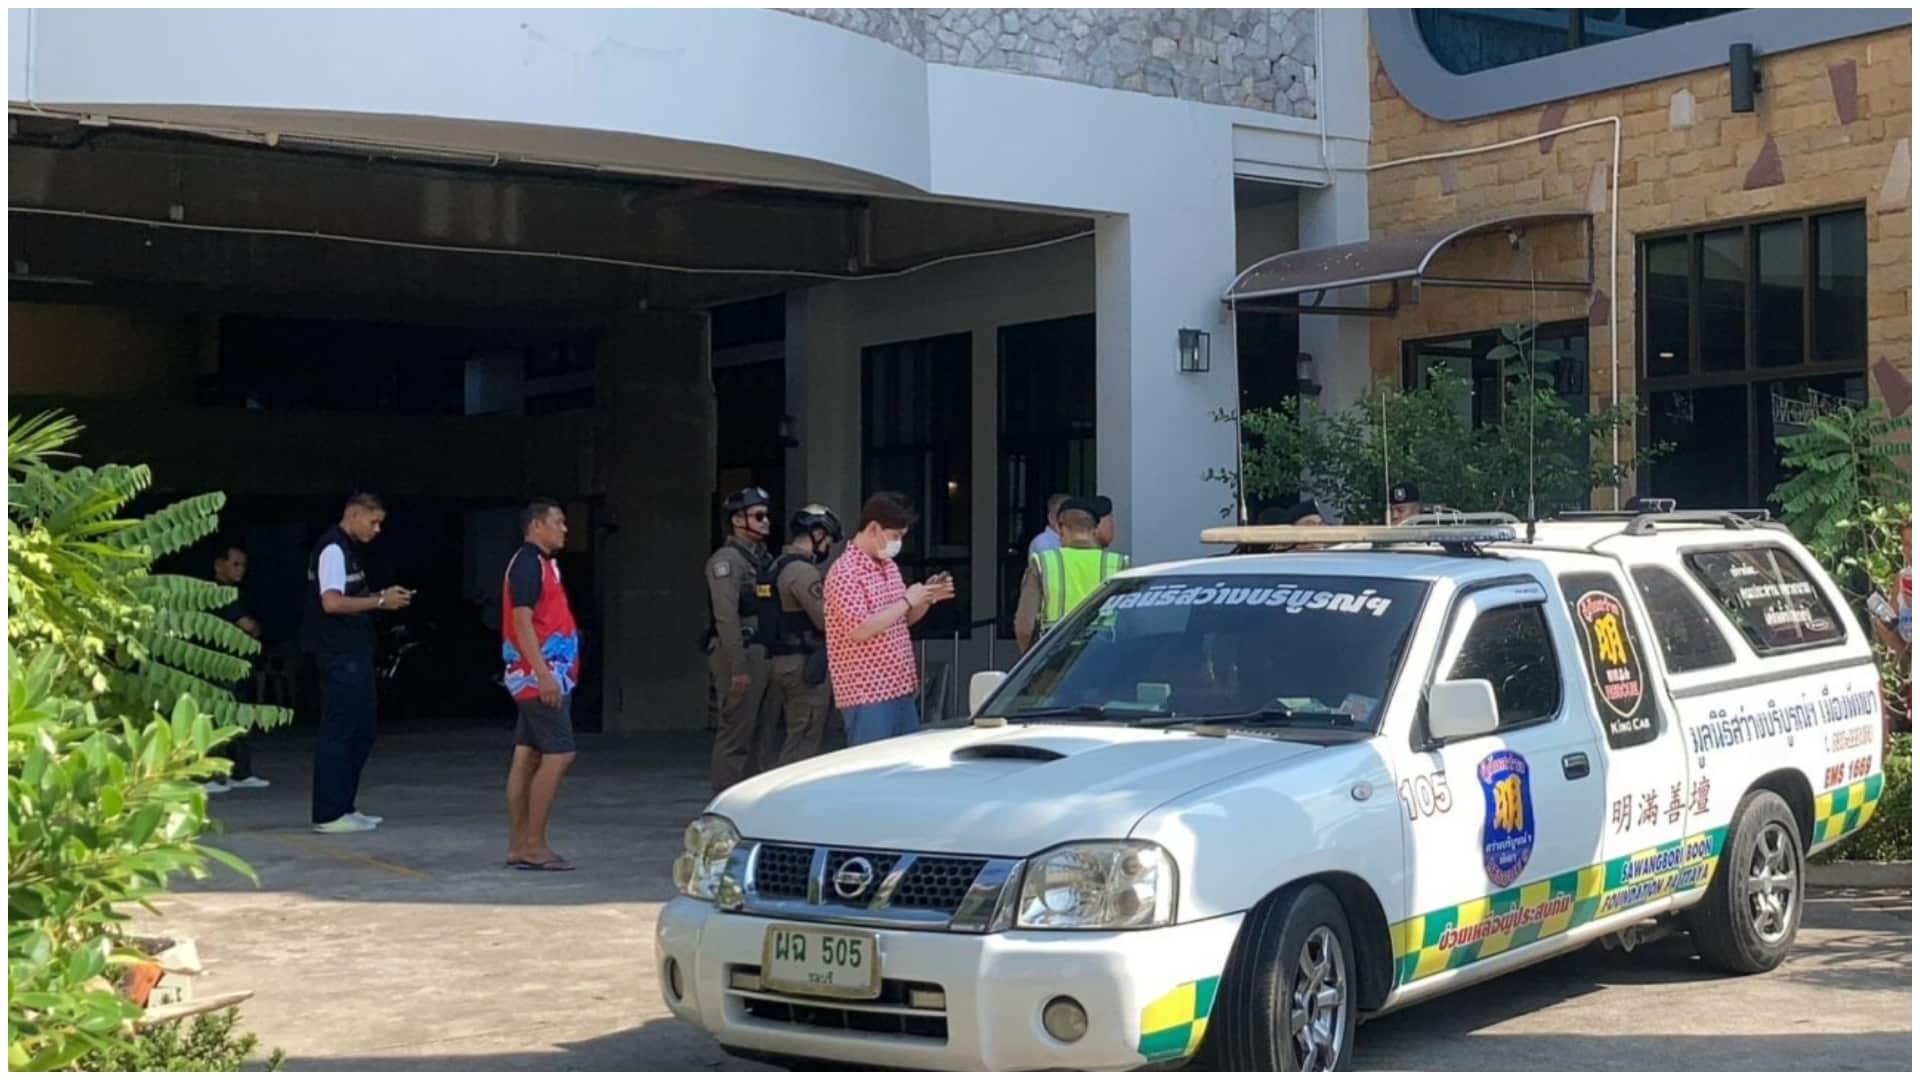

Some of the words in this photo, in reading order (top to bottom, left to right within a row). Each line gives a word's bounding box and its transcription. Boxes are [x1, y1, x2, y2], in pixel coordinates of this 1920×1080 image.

[1594, 612, 1627, 665] 明
[1400, 769, 1453, 821] 105
[1824, 762, 1845, 789] EMS
[1848, 755, 1872, 780] 1669
[1493, 773, 1524, 833] 明
[822, 936, 862, 968] 505
